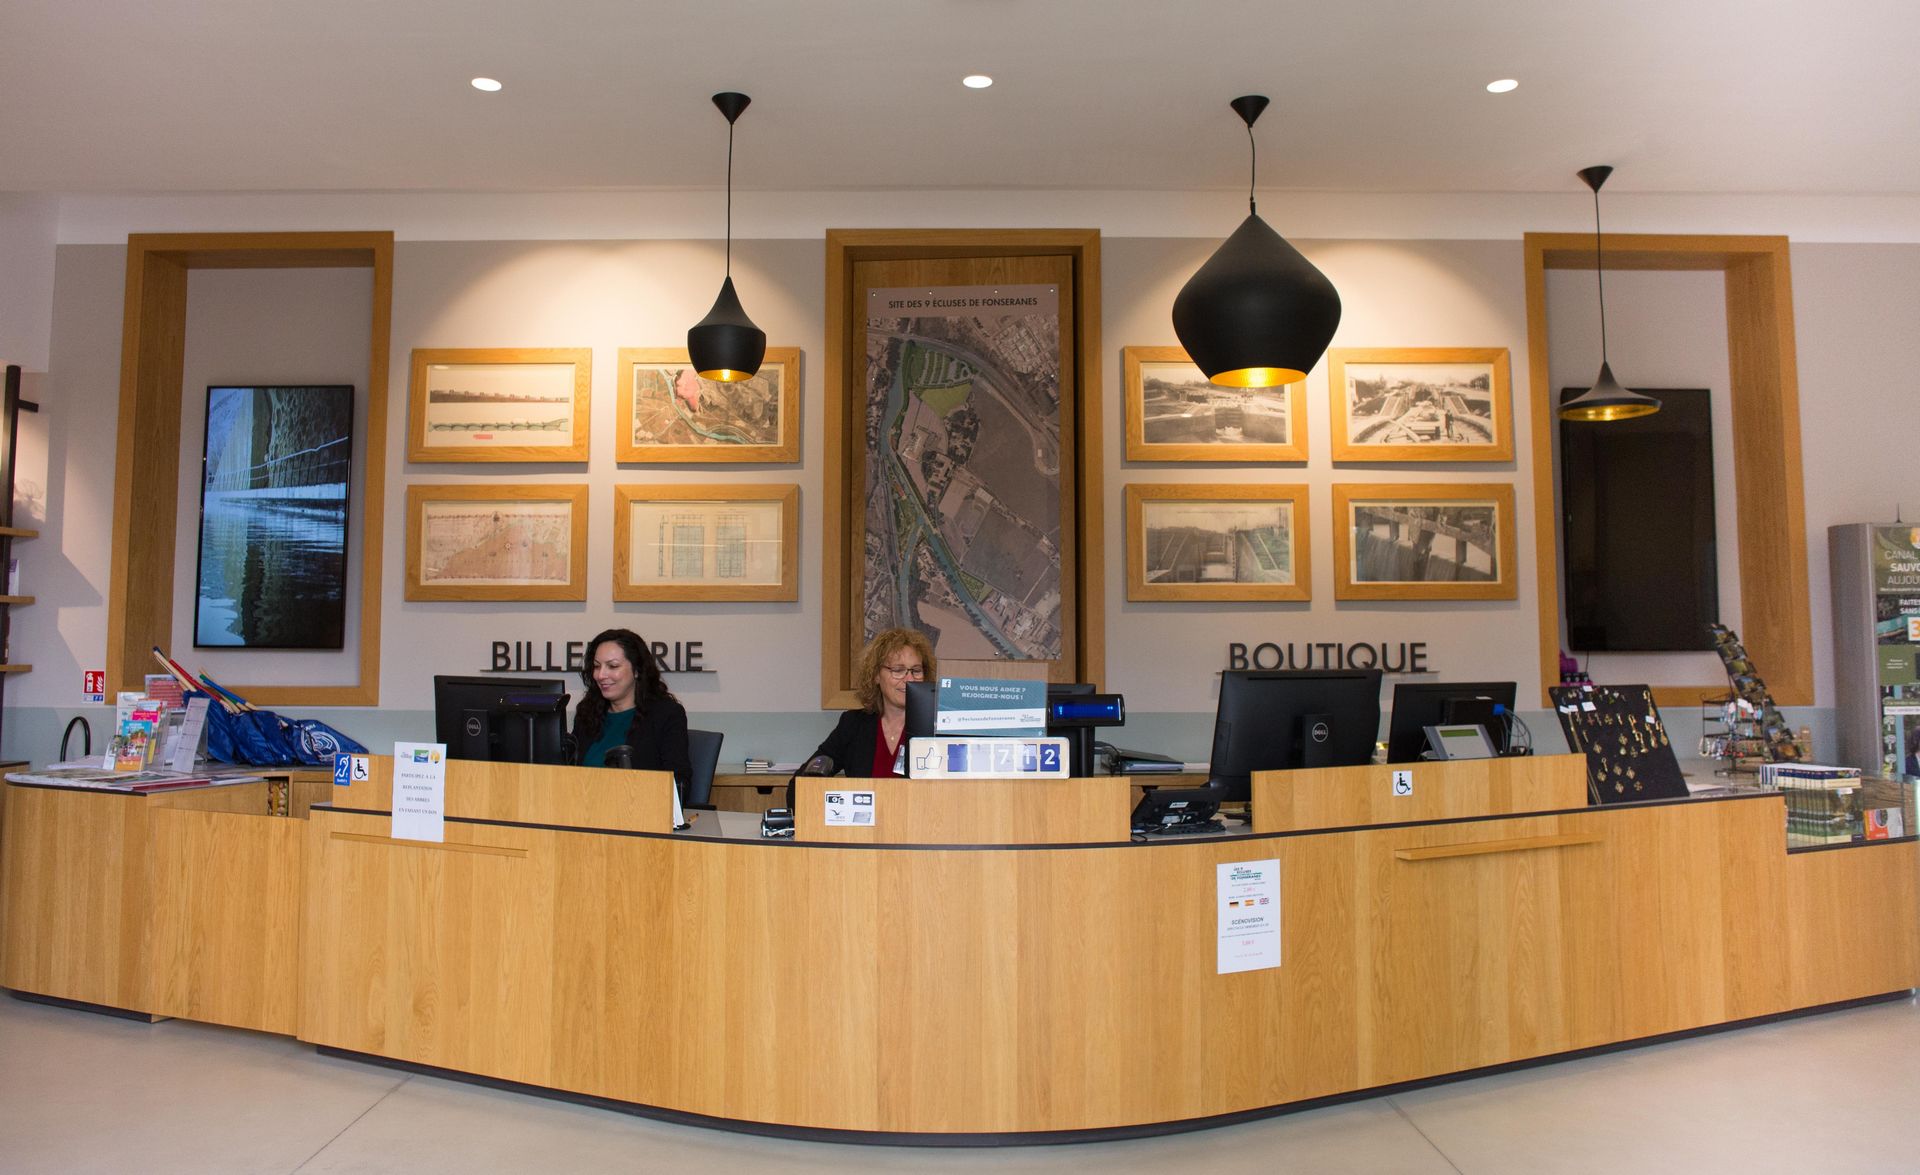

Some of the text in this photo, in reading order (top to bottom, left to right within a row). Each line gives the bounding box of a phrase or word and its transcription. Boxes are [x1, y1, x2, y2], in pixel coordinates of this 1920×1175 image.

[888, 300, 904, 308] SITE
[907, 300, 922, 308] DES
[933, 298, 966, 308] ÉCLUSES
[982, 298, 1038, 306] FONSERANES
[1884, 550, 1918, 560] CANAL
[492, 641, 703, 672] BILLERIE
[1230, 642, 1427, 672] BOUTIQUE
